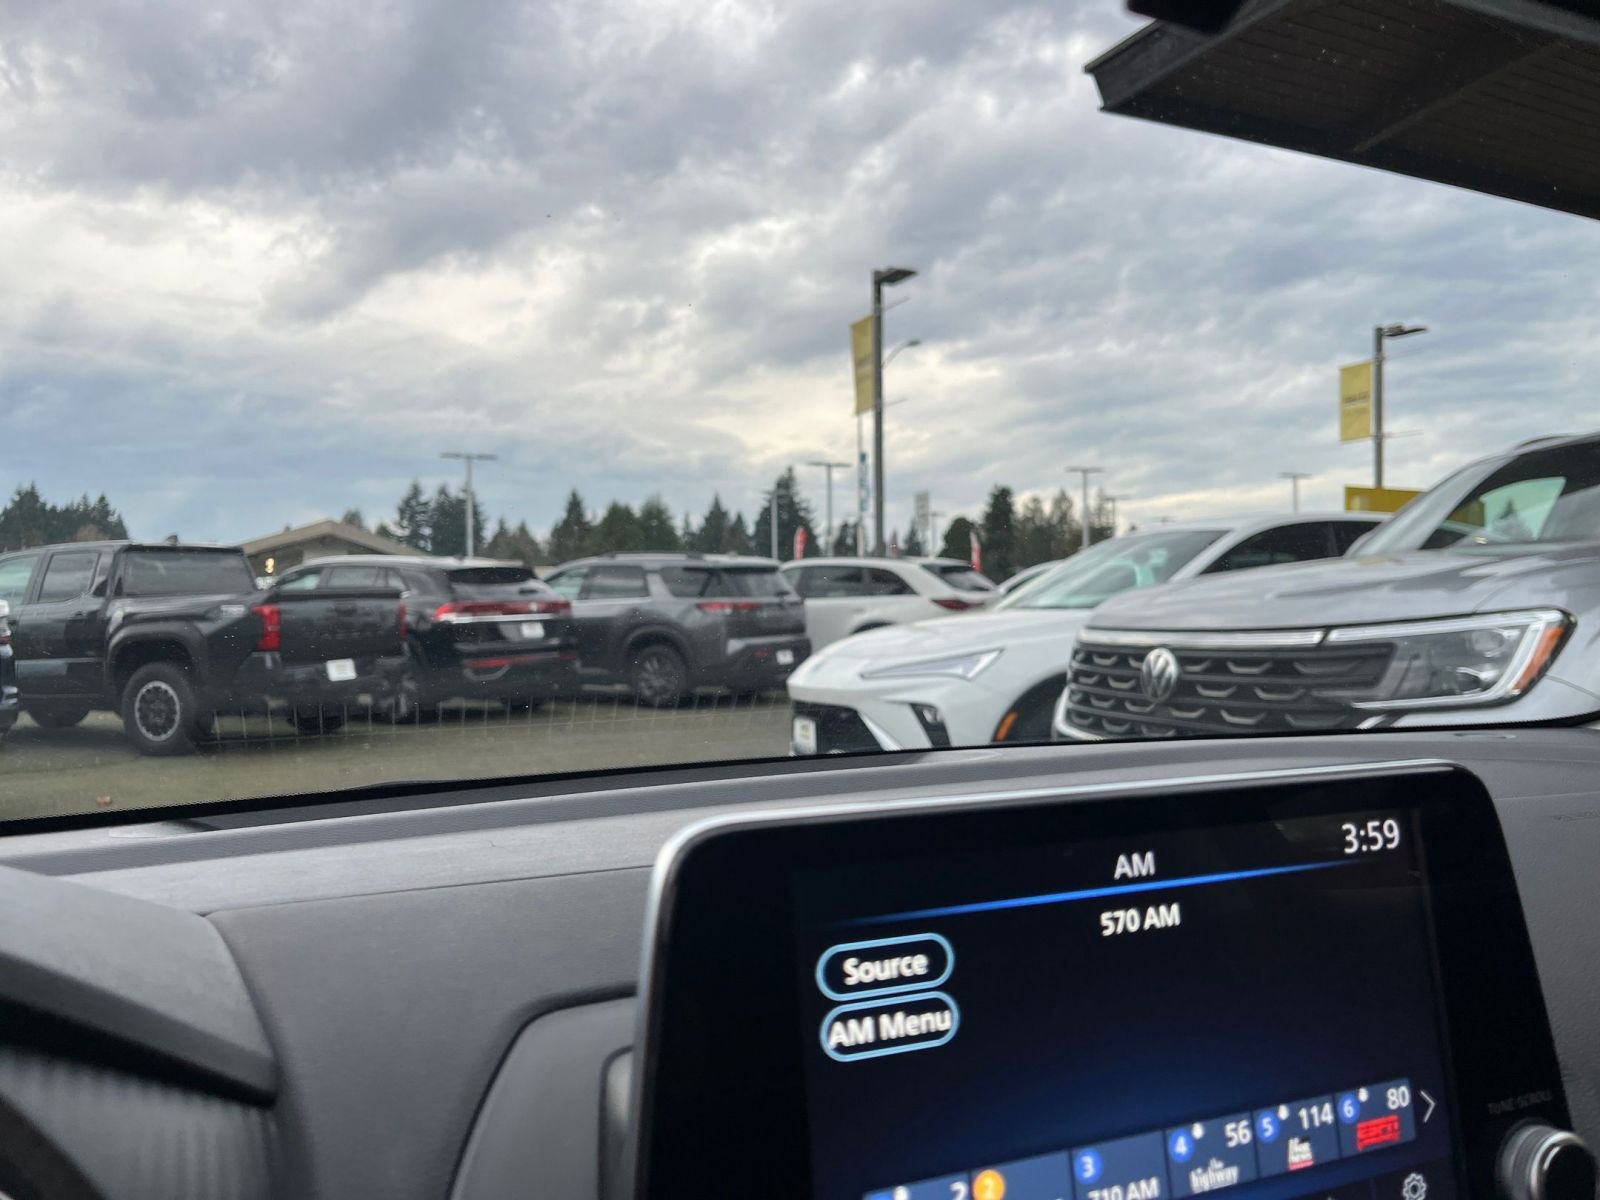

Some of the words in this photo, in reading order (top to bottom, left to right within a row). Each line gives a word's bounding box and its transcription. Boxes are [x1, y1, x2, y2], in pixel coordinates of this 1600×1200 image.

[1341, 818, 1400, 854] 3:59
[1113, 850, 1156, 880] AM
[1099, 908, 1141, 937] 570
[1143, 902, 1182, 931] AM
[842, 953, 929, 986] Source
[828, 1015, 876, 1049] AM
[878, 1010, 952, 1041] Menu
[1343, 1099, 1355, 1119] 6
[1386, 1085, 1411, 1110] 80
[1261, 1116, 1275, 1138] 5
[1298, 1102, 1335, 1131] 114
[1175, 1134, 1188, 1156] 4
[1225, 1119, 1253, 1149] 56
[1081, 1154, 1096, 1179] 3
[1126, 1176, 1160, 1200] AM
